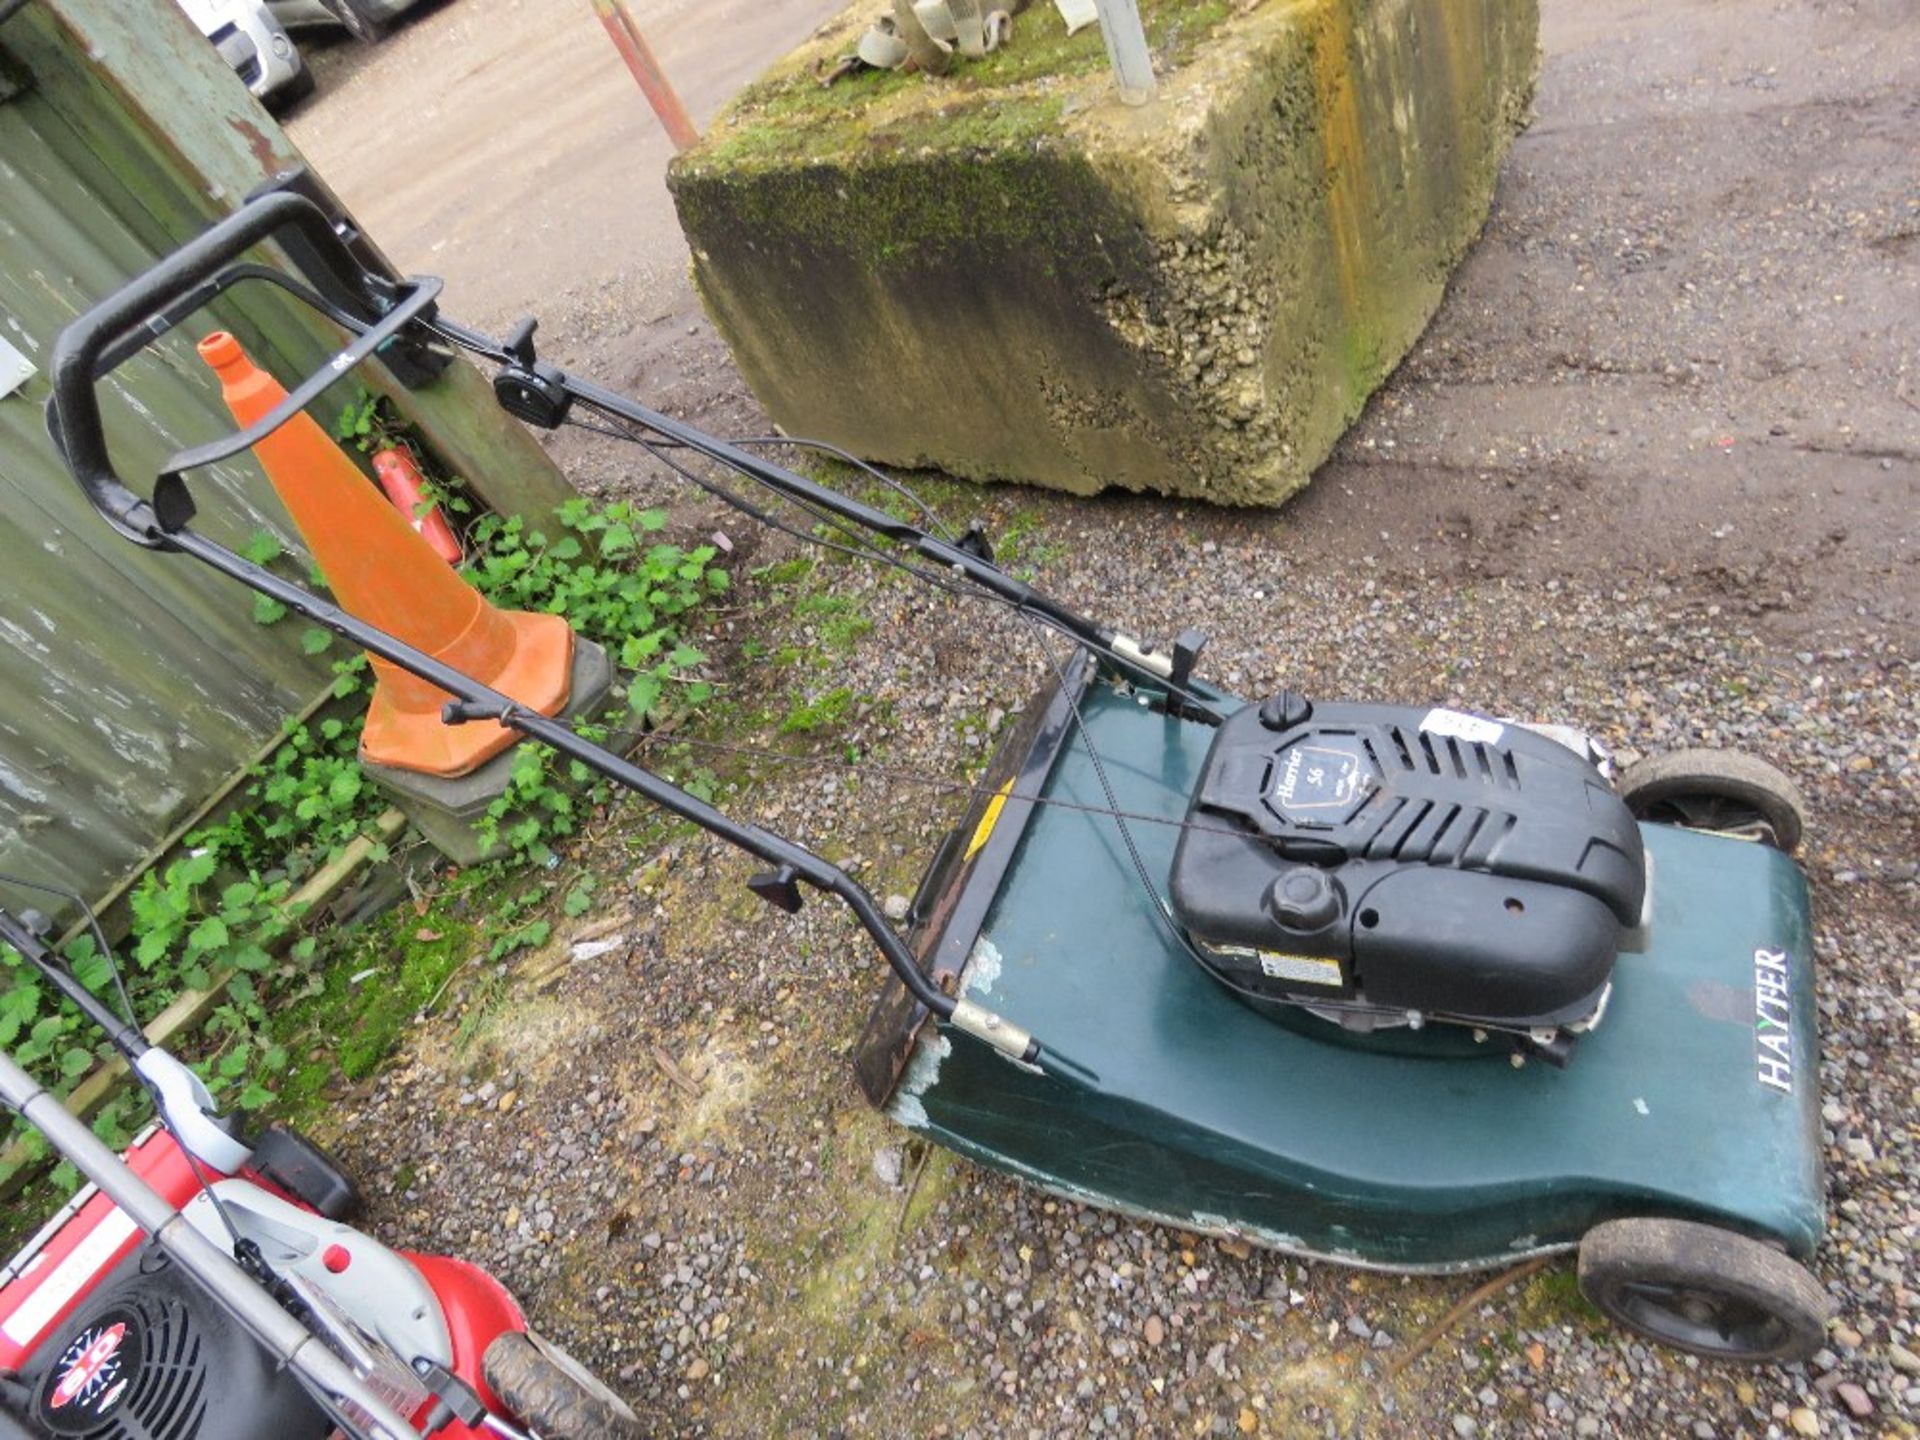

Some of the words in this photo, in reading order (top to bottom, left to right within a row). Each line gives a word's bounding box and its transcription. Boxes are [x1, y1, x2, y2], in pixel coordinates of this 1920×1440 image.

[1275, 748, 1303, 799] Harrier
[1307, 767, 1325, 787] 56
[1755, 948, 1792, 1092] HAYTER
